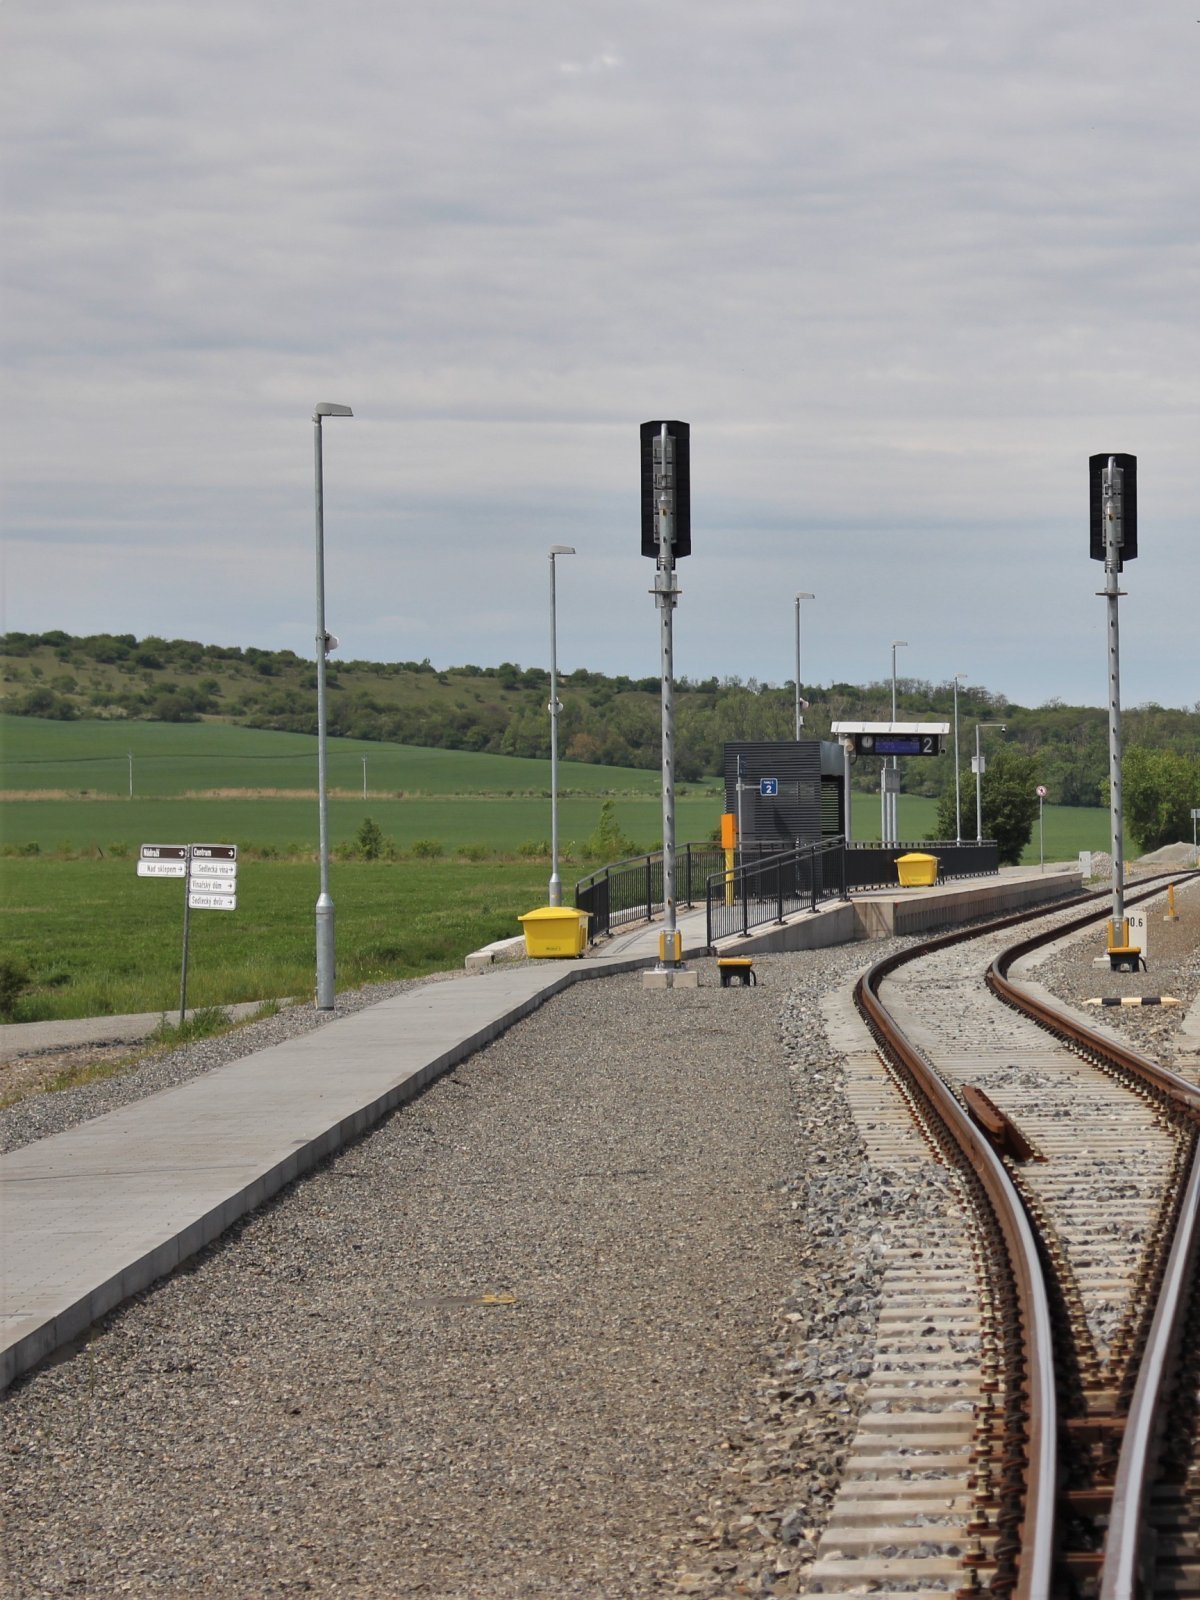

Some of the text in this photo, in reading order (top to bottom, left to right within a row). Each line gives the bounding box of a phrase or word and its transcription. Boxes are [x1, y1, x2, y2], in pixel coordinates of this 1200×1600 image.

[923, 737, 933, 753] 2
[766, 785, 772, 793] 2
[193, 847, 212, 857] Centrum
